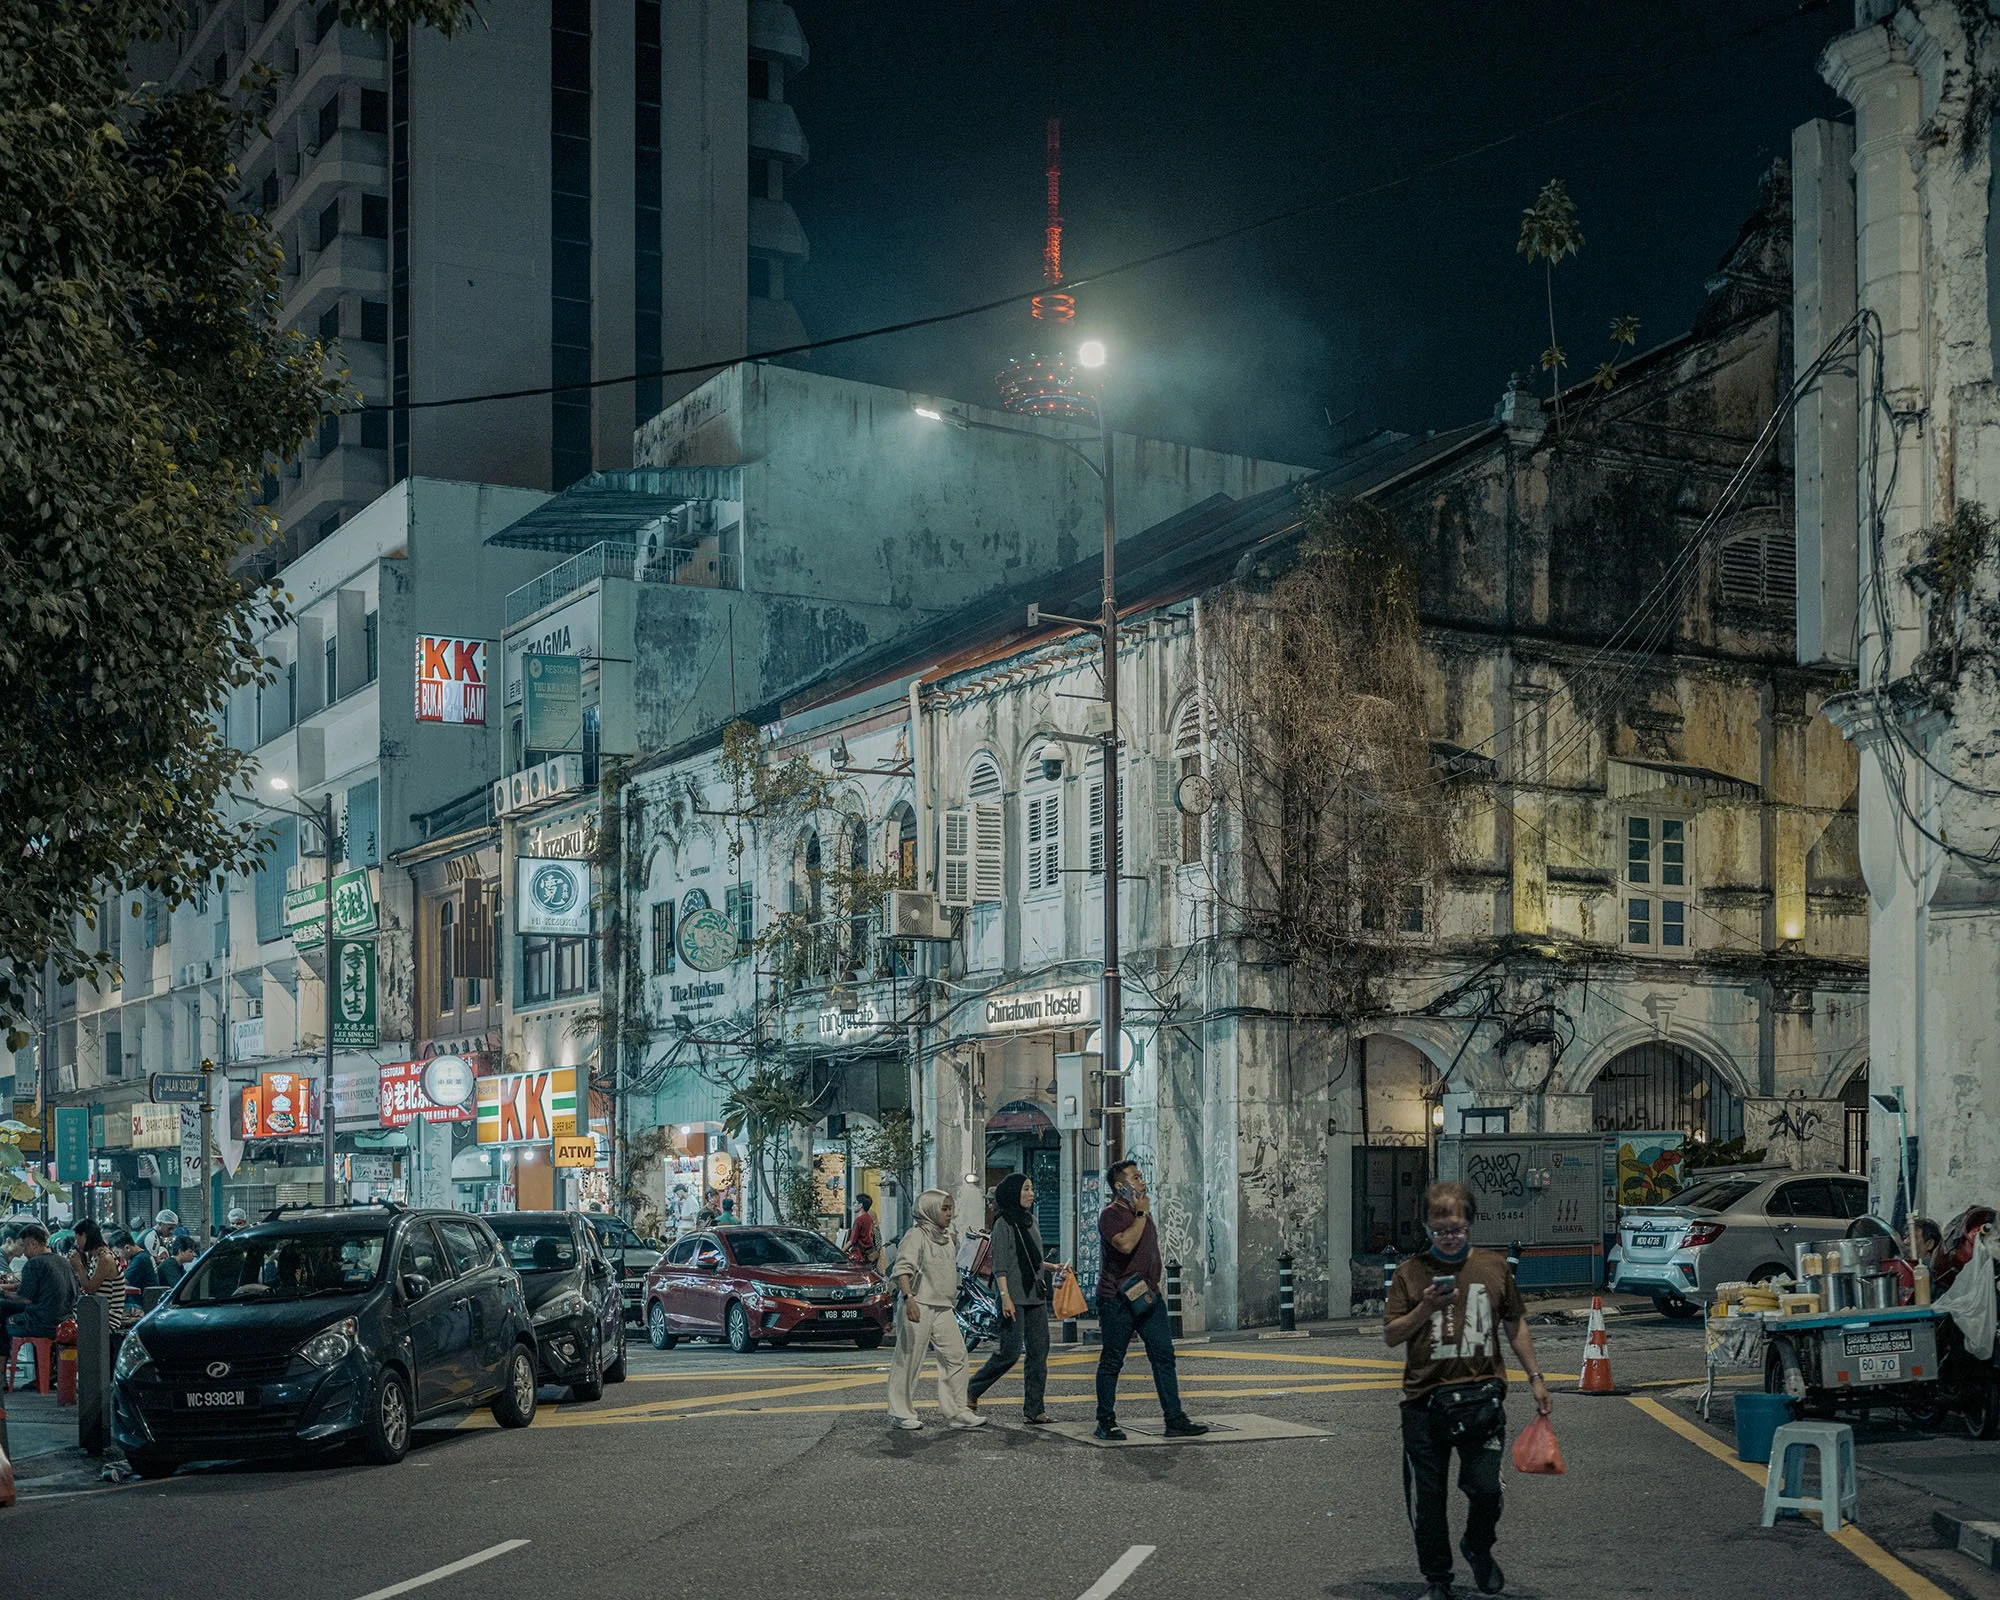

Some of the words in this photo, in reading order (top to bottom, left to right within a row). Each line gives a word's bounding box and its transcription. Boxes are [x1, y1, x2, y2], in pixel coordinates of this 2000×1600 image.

[424, 638, 482, 683] KK
[422, 683, 443, 716] BUKA
[464, 687, 484, 720] JAM
[986, 999, 1042, 1024] Chinatown
[1044, 990, 1082, 1017] Hostel
[381, 1066, 405, 1078] RESTORAN
[164, 1079, 179, 1091] JALAN
[500, 1072, 550, 1141] KK
[559, 1146, 591, 1159] ATM
[1476, 1213, 1495, 1221] TEL:
[841, 1310, 858, 1319] 3019
[1862, 1358, 1874, 1371] 60
[1881, 1359, 1896, 1371] 70
